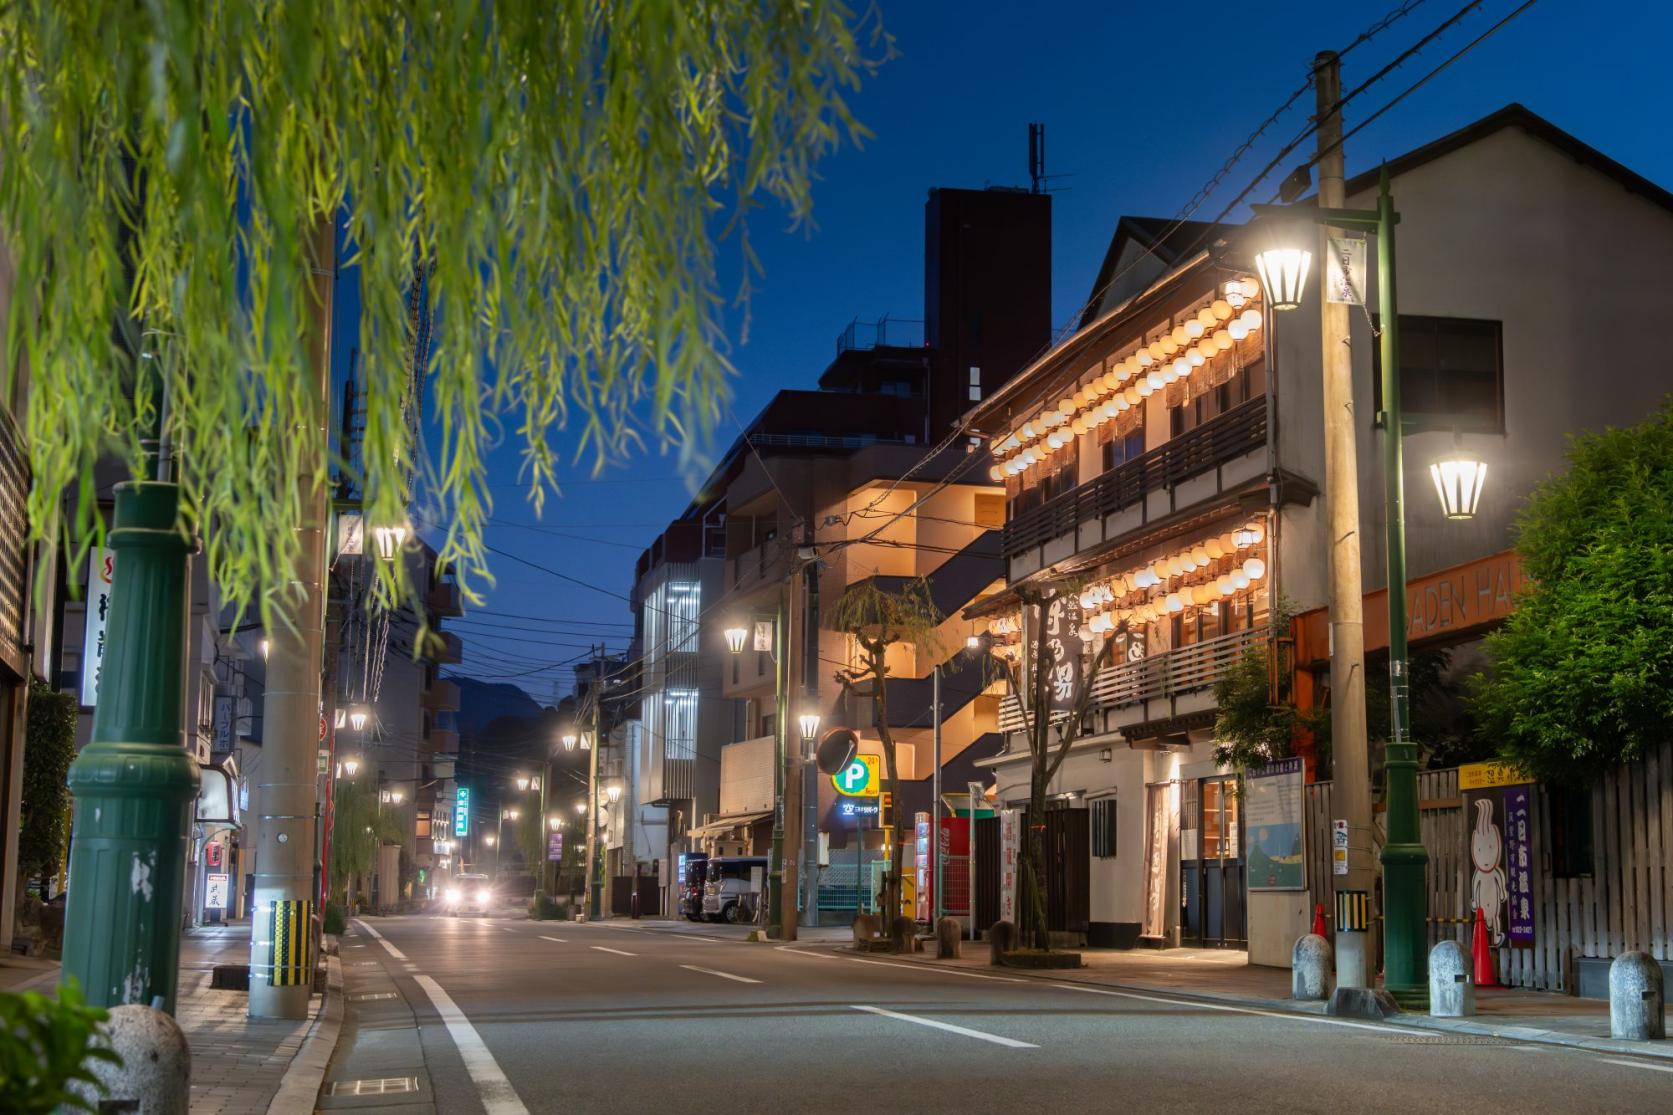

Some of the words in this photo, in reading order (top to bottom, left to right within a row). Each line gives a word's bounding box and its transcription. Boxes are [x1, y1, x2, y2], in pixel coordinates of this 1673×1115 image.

[1406, 575, 1466, 635] ADEN
[845, 763, 864, 789] P
[1516, 795, 1530, 919] 二日市温泉
